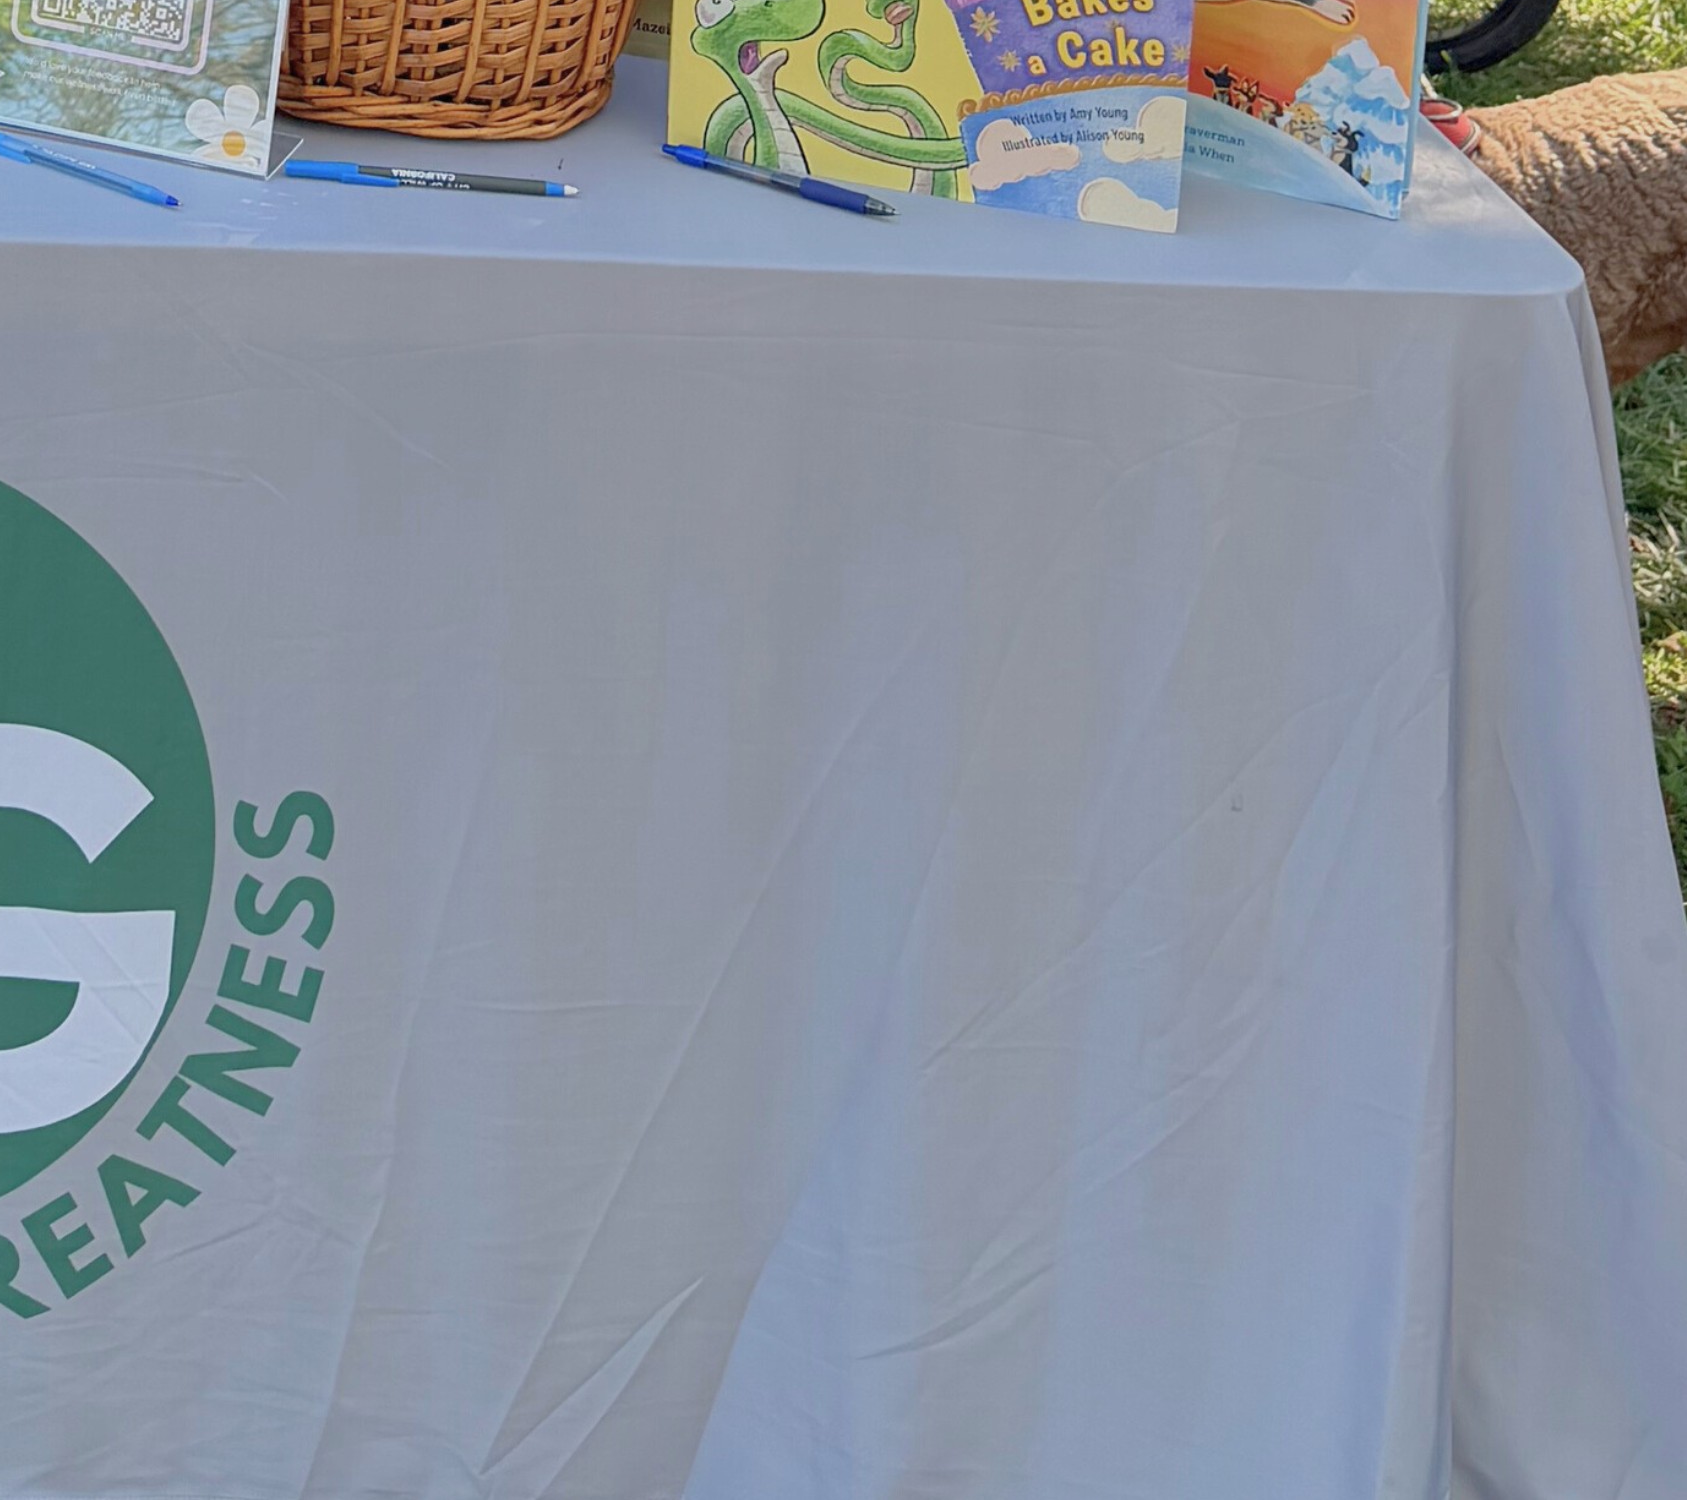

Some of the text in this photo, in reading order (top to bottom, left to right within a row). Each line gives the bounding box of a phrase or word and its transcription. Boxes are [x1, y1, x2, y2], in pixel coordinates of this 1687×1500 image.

[1027, 27, 1165, 75] a Cake
[1010, 106, 1128, 127] Written by Amy Young
[1002, 128, 1145, 152] Illustrated by Alison Young
[1185, 127, 1245, 147] raverman
[1198, 145, 1235, 164] When
